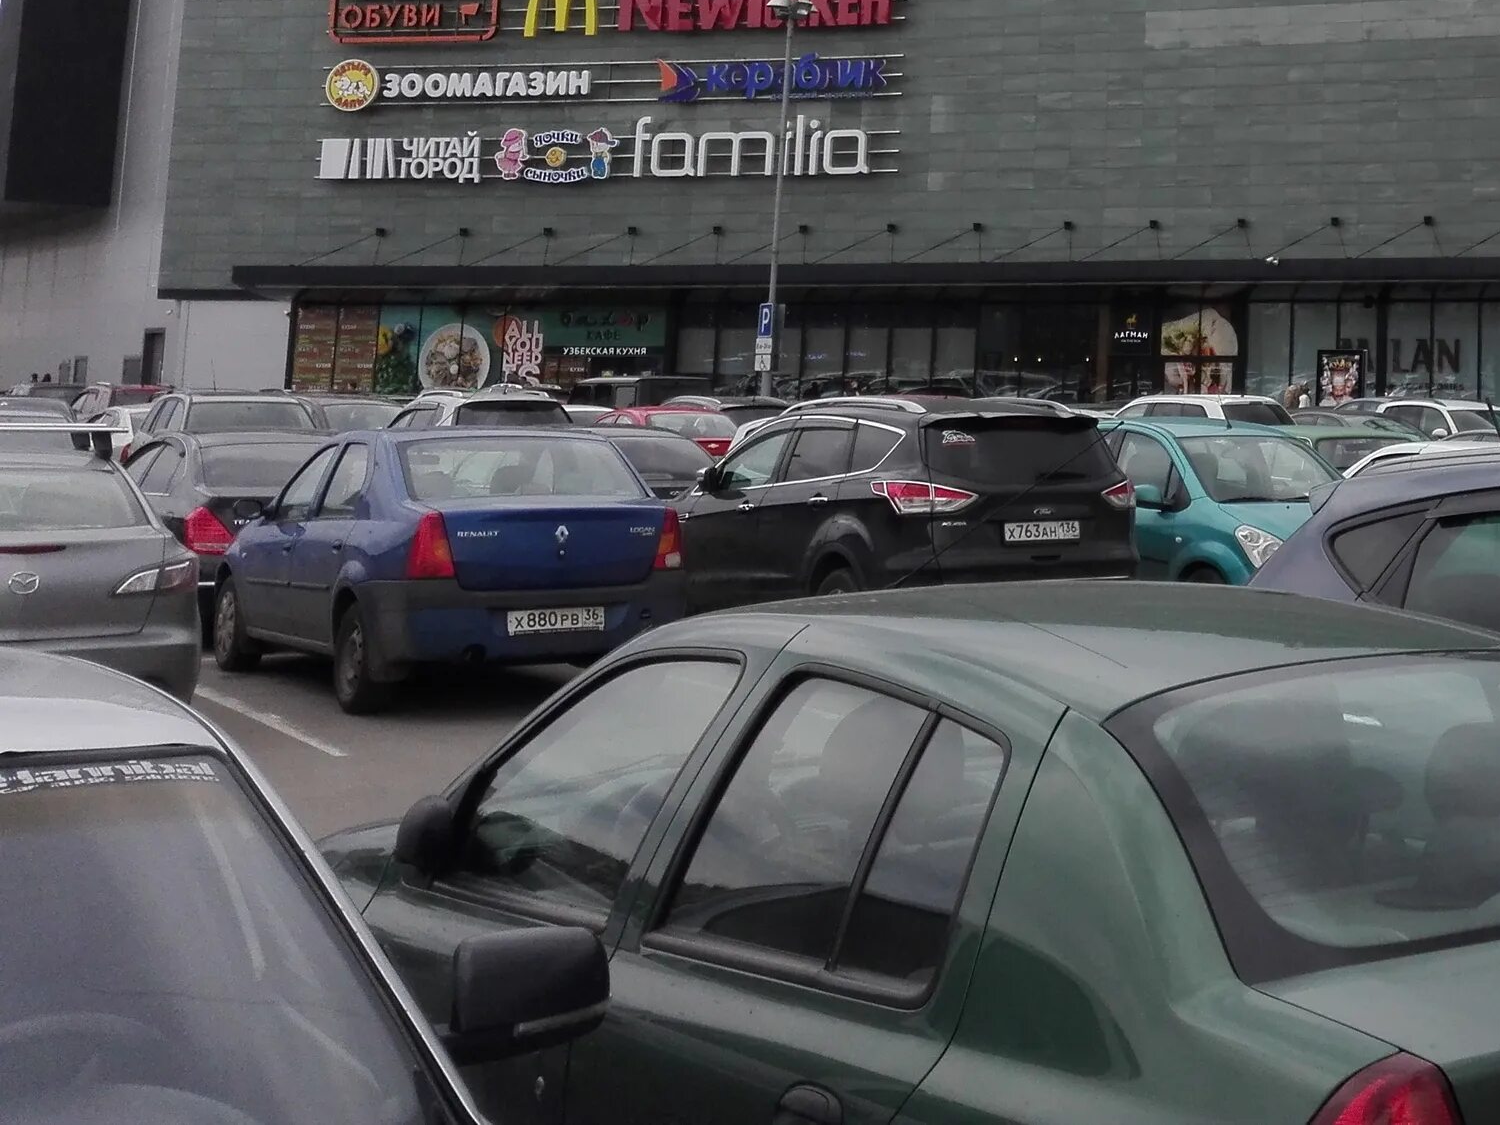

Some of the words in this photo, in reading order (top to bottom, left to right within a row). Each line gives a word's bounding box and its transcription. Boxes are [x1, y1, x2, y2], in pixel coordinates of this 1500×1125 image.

[340, 2, 442, 28] ОБУВИ
[383, 70, 592, 98] ЗООМАГАЗИН
[402, 131, 481, 158] ЧИТАЙ
[633, 116, 869, 176] familia
[400, 158, 481, 183] ГОРОД
[506, 320, 540, 338] ALL
[762, 308, 770, 333] P
[505, 334, 543, 352] YOU
[1114, 331, 1148, 339] ЛАГМАН
[503, 351, 541, 367] NEED
[563, 347, 615, 355] УЗБЕКСКАЯ
[616, 347, 647, 355] КУХНЯ
[1340, 338, 1460, 373] MLAN
[1059, 522, 1077, 534] 136
[584, 608, 599, 621] 36
